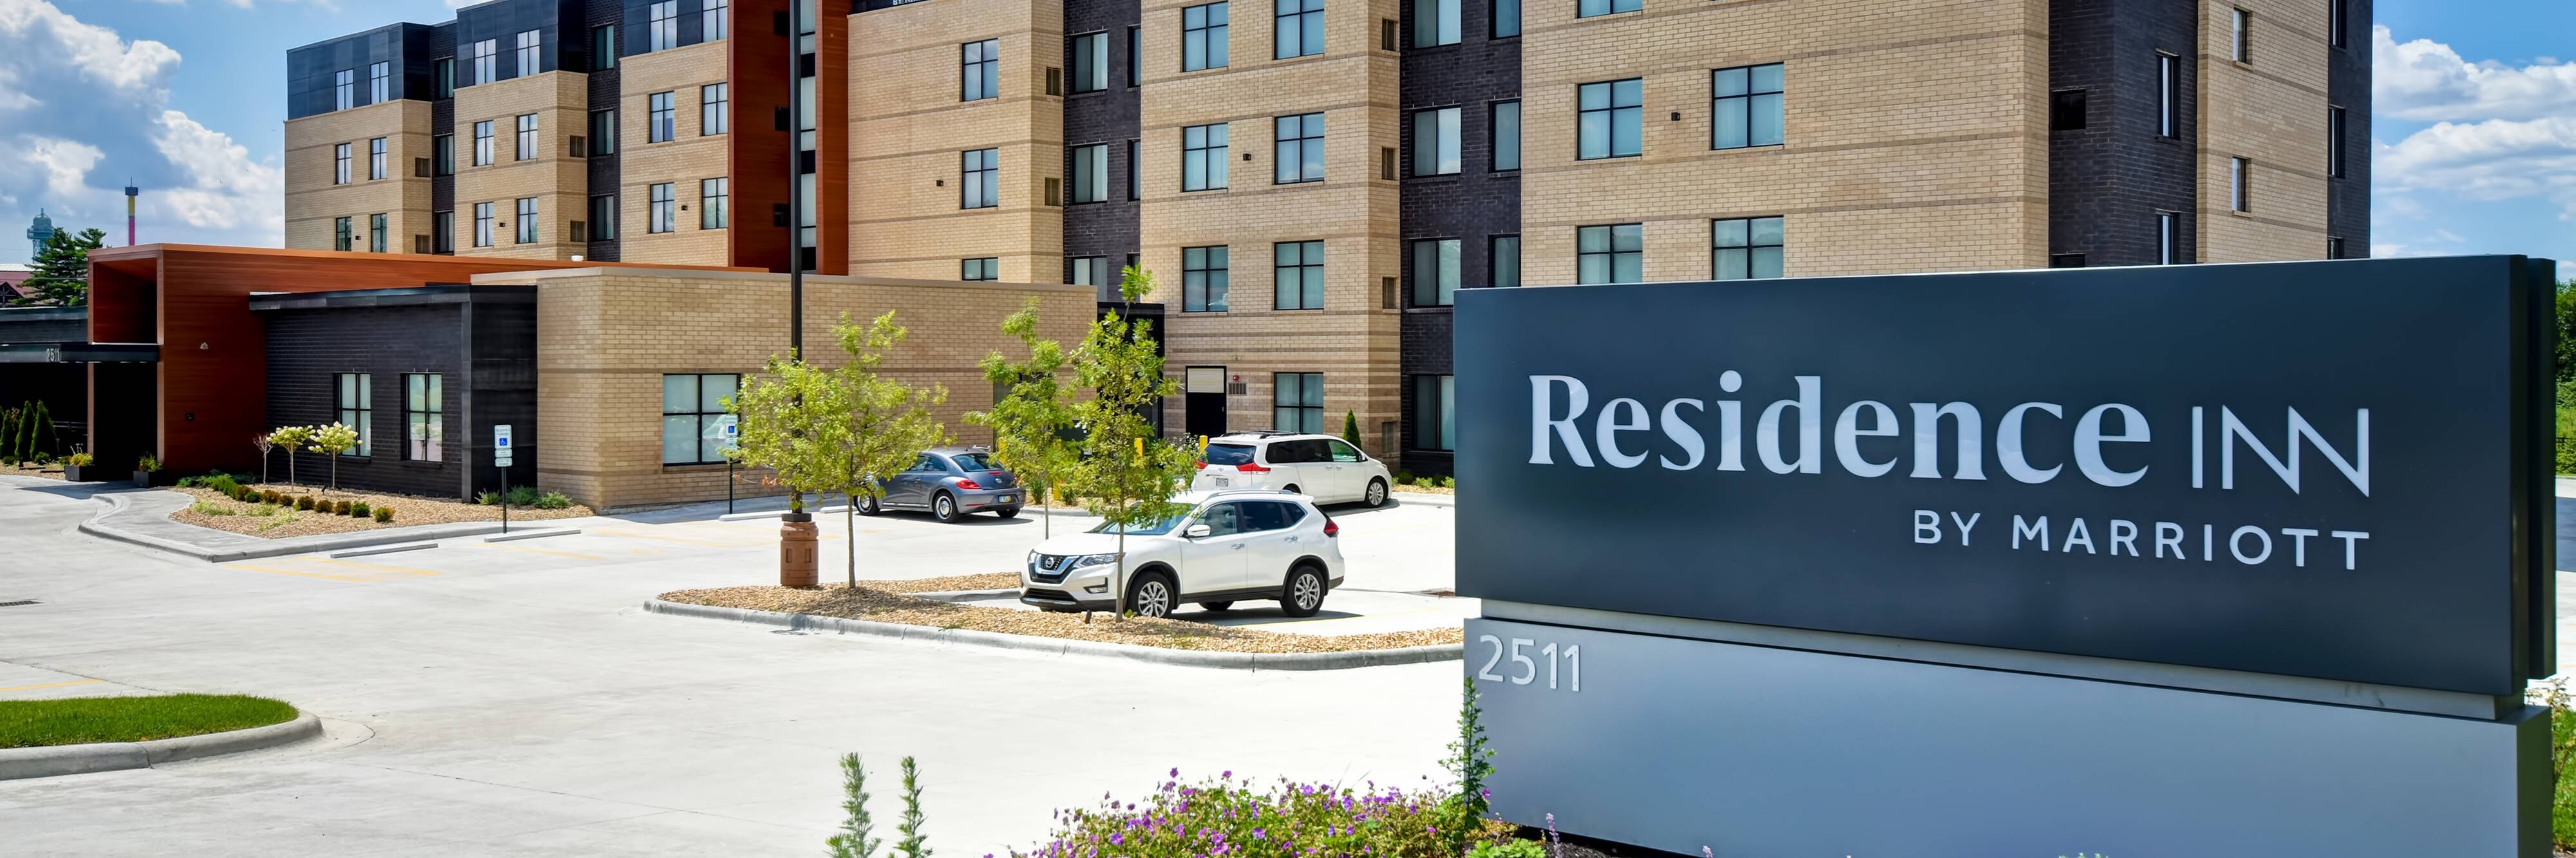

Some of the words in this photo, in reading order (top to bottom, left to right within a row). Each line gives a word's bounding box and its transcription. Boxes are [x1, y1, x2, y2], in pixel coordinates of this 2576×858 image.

[1528, 370, 2151, 487] Residence
[2192, 405, 2369, 497] INN
[1914, 510, 1980, 546] BY
[2012, 515, 2369, 570] MARRIOTT
[1479, 635, 1580, 691] 2511
